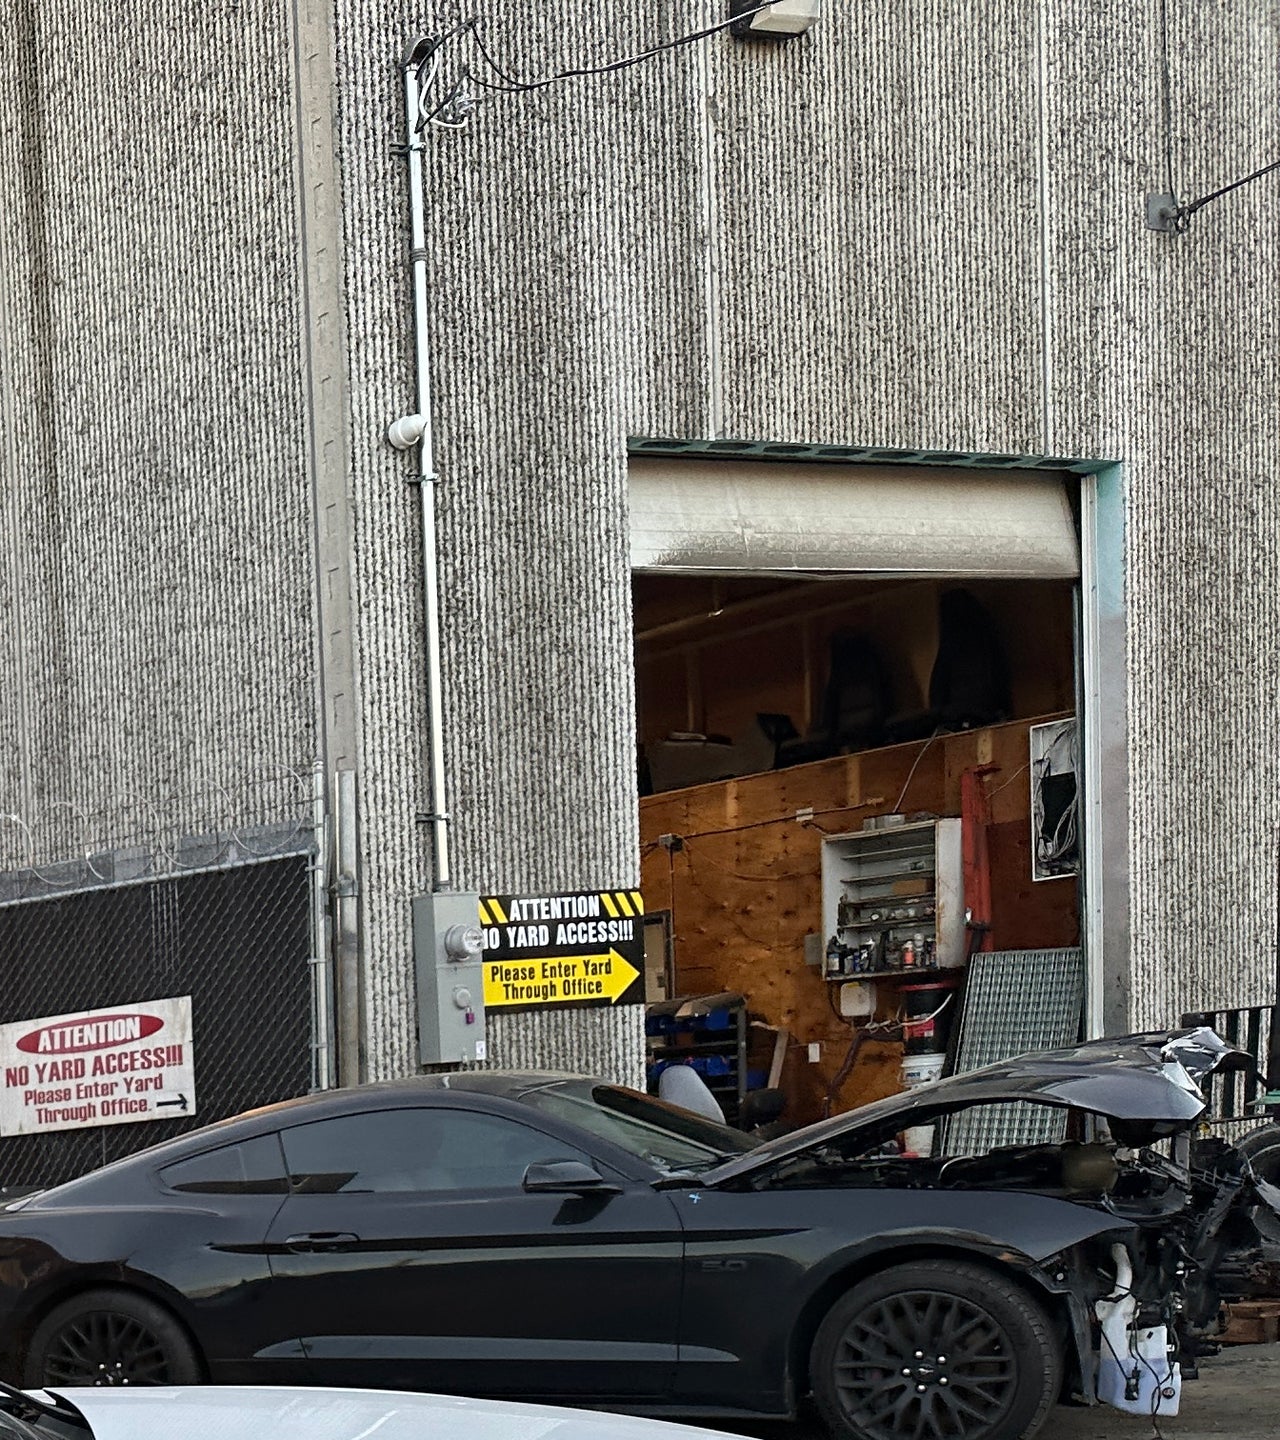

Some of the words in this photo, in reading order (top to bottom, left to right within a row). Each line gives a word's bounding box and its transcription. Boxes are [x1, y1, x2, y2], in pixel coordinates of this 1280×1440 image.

[509, 894, 600, 922] ATTENTION
[506, 924, 550, 948] YARD
[556, 919, 634, 946] ACCESS!!!
[491, 964, 535, 983] Please
[541, 962, 577, 980] Enter
[582, 958, 612, 976] Yard
[502, 980, 557, 1001] Through
[563, 978, 602, 996] Office
[37, 1015, 141, 1053] ATTENTION
[5, 1065, 30, 1088] NO
[34, 1057, 86, 1083] YARD
[91, 1043, 183, 1078] ACCESS!!!
[24, 1088, 72, 1106] Please
[75, 1078, 118, 1098] Enter
[123, 1073, 164, 1093] Yard
[36, 1102, 96, 1125] Through
